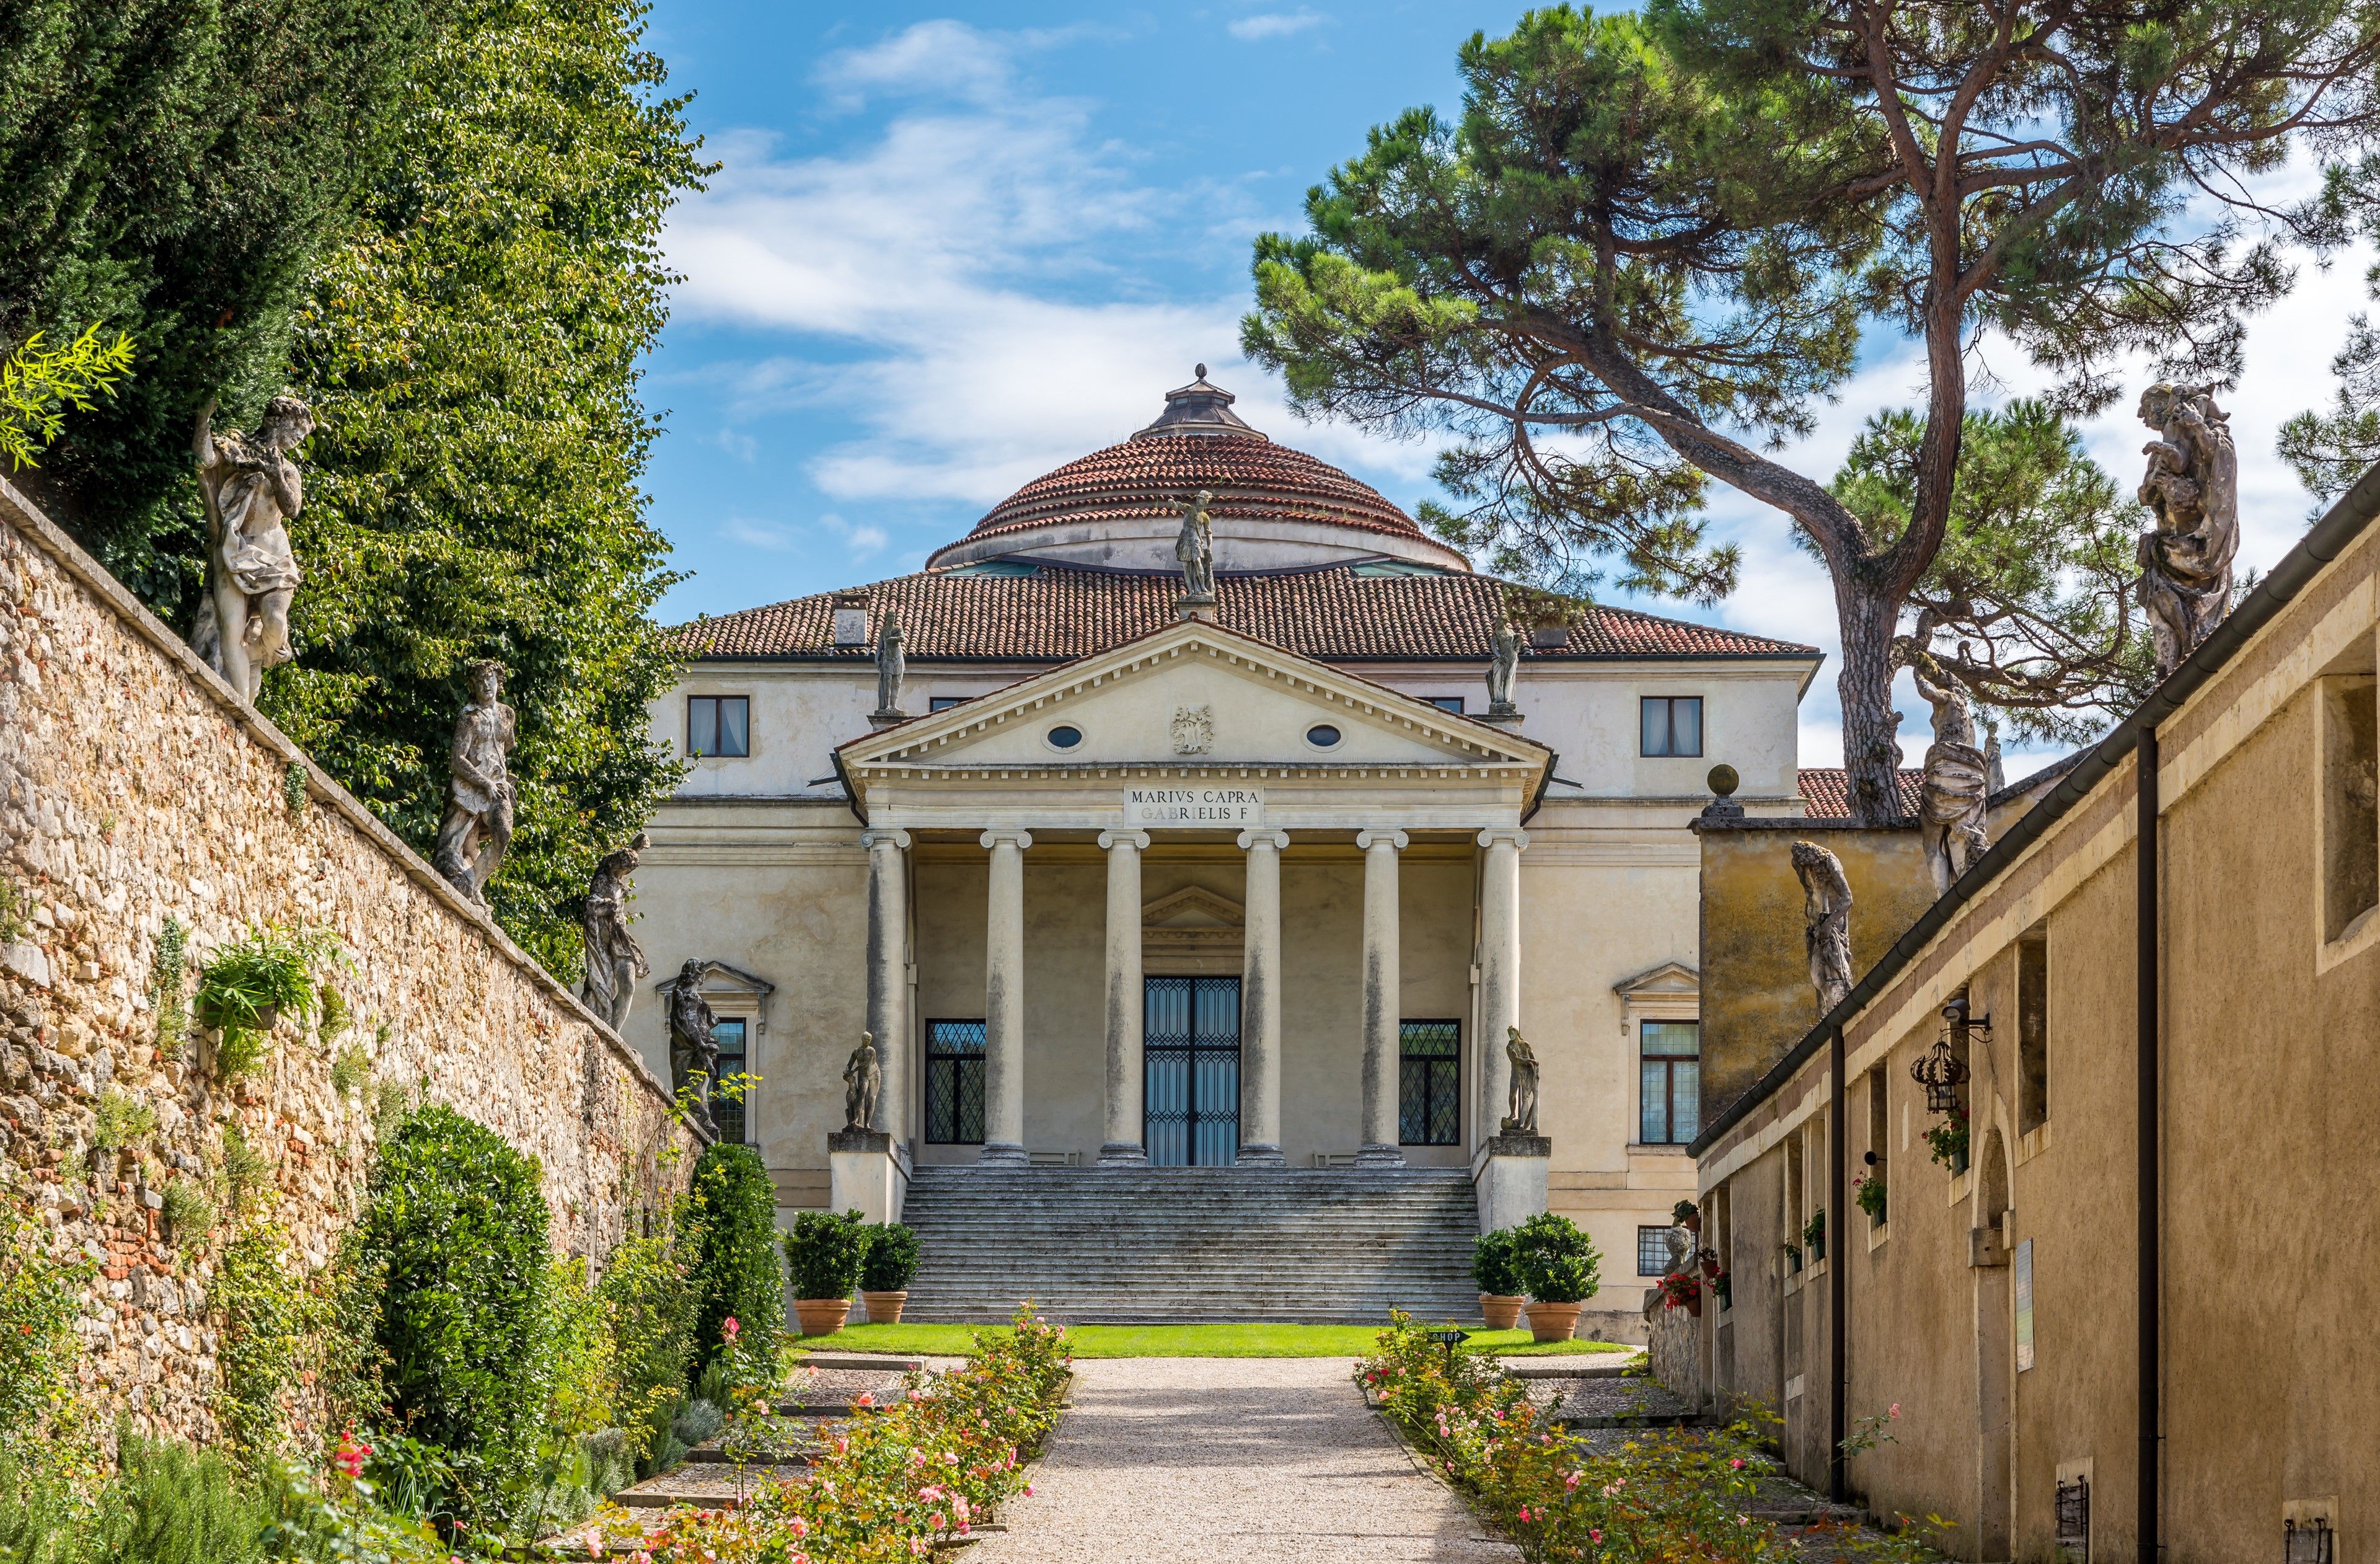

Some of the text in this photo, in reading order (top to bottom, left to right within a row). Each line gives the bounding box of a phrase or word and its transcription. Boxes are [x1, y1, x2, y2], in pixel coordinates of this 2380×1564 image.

[1132, 791, 1259, 803] MARIVS CAPRA
[1142, 807, 1248, 820] GABRIELIS F
